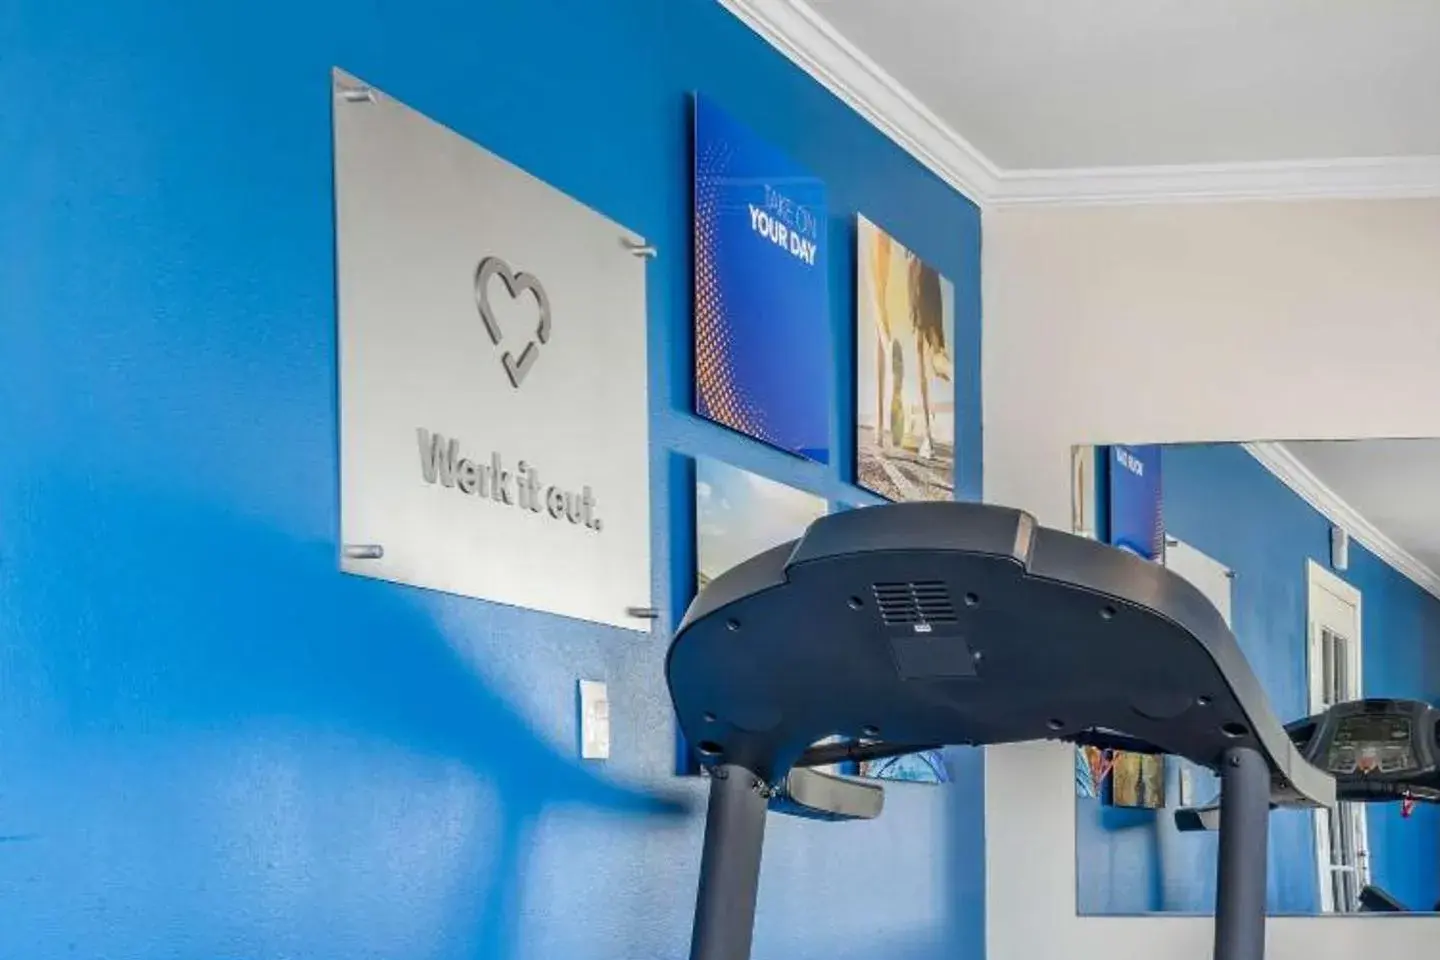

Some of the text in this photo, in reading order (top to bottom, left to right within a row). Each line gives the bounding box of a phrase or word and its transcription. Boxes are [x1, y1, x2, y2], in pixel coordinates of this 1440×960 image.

[748, 203, 817, 266] YOUR DAY
[416, 427, 514, 506] Work
[516, 459, 542, 513] it
